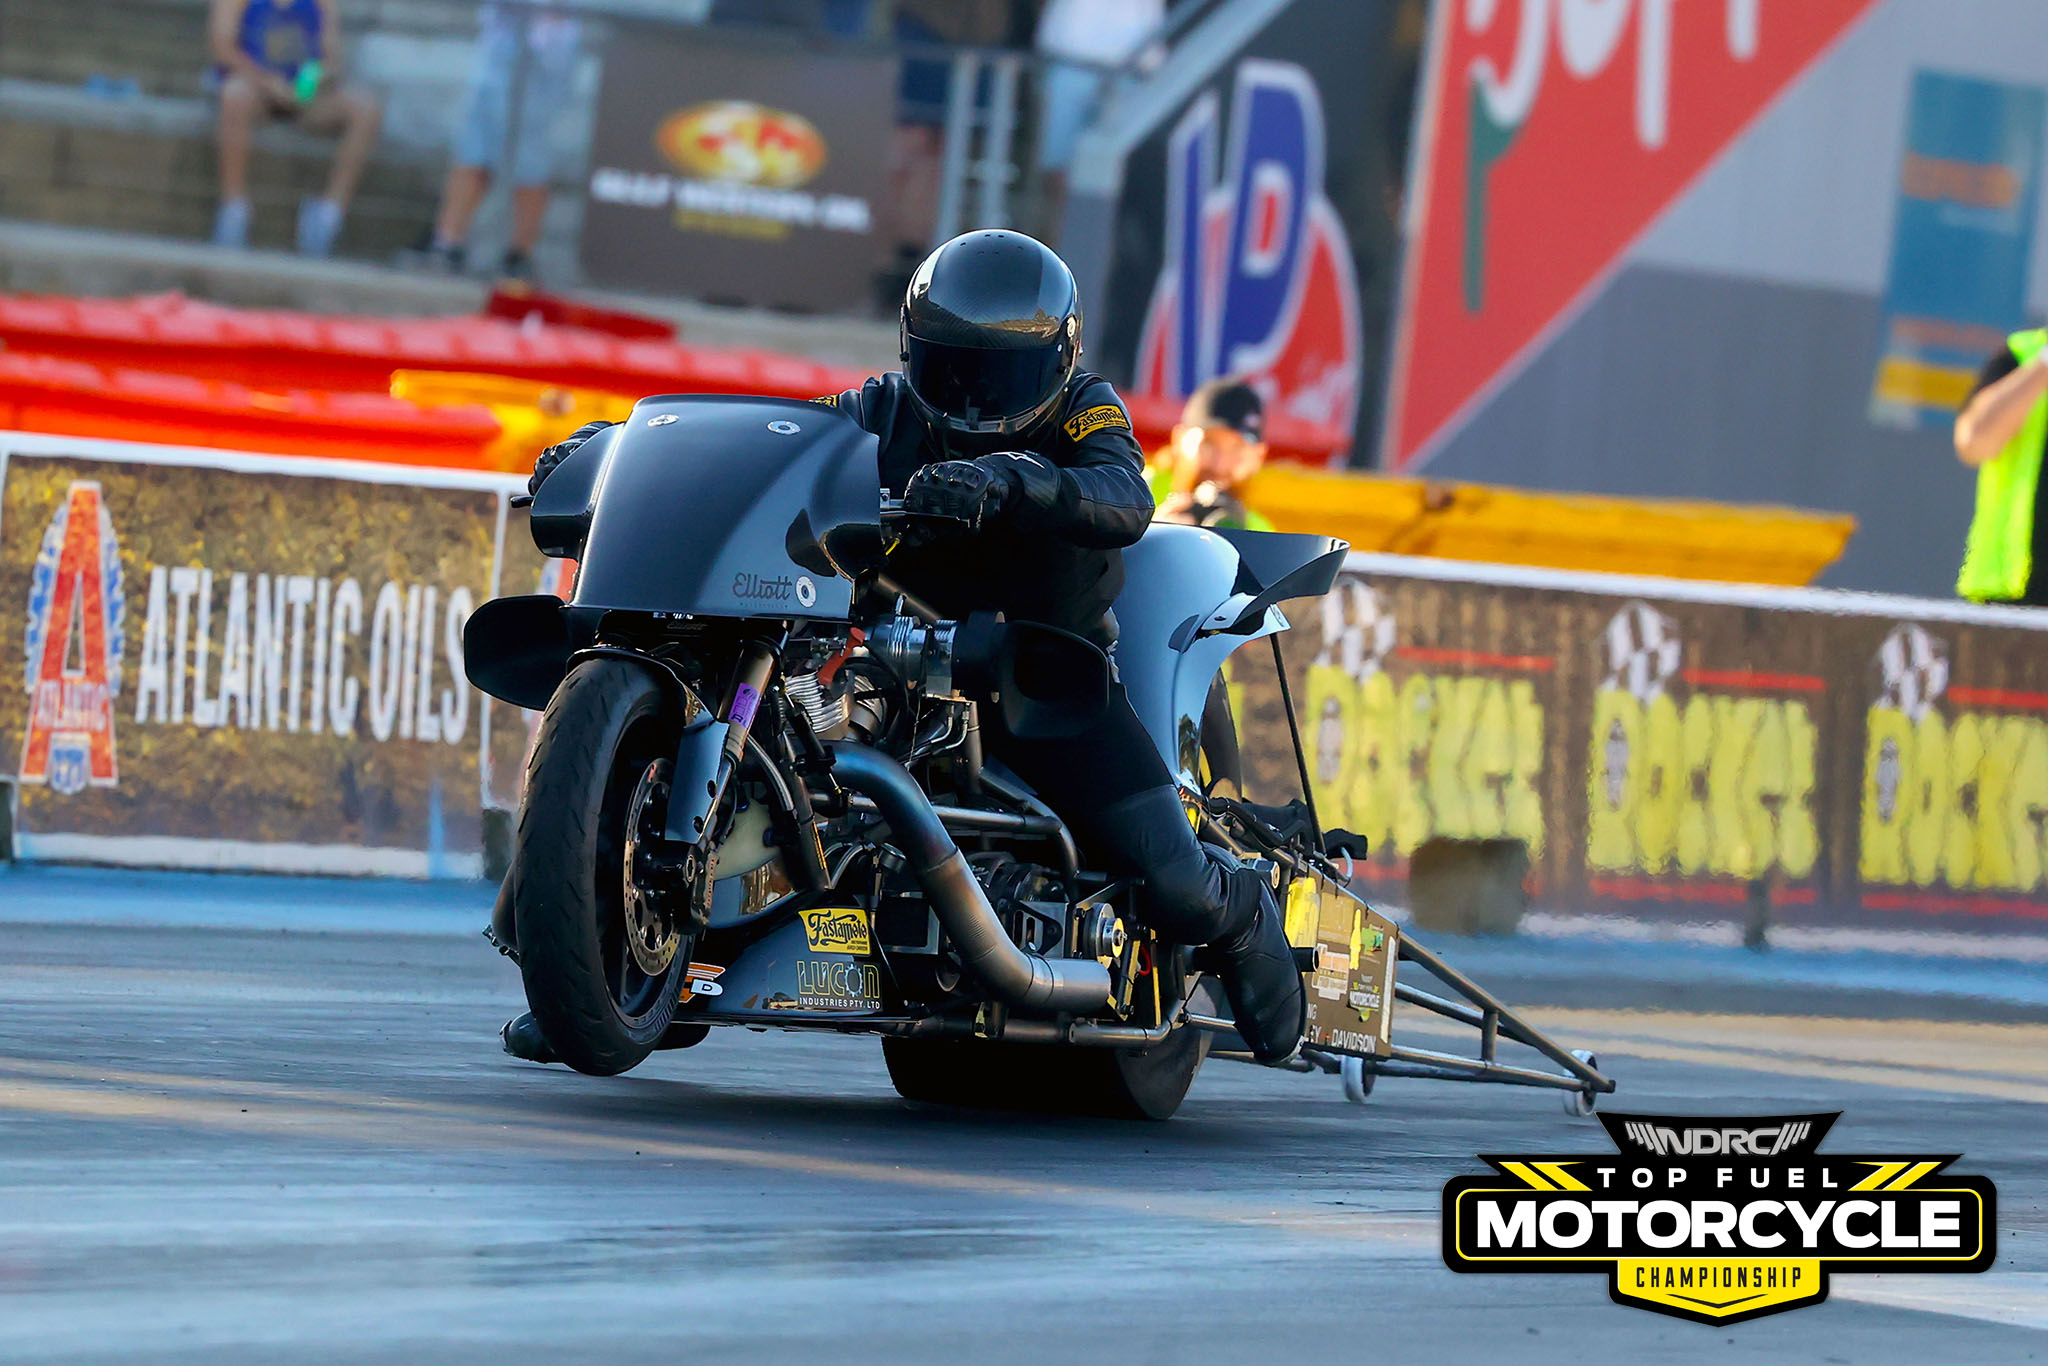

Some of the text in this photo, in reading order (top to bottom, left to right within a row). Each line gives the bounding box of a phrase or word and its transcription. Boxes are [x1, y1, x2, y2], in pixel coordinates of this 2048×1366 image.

[733, 573, 792, 600] Elliott
[136, 566, 474, 745] ATLANTIC OILS
[797, 961, 880, 998] LUCON
[800, 997, 848, 1007] INDUSTRIES
[867, 1001, 880, 1009] LTD
[1331, 1028, 1376, 1053] DAVIDSON
